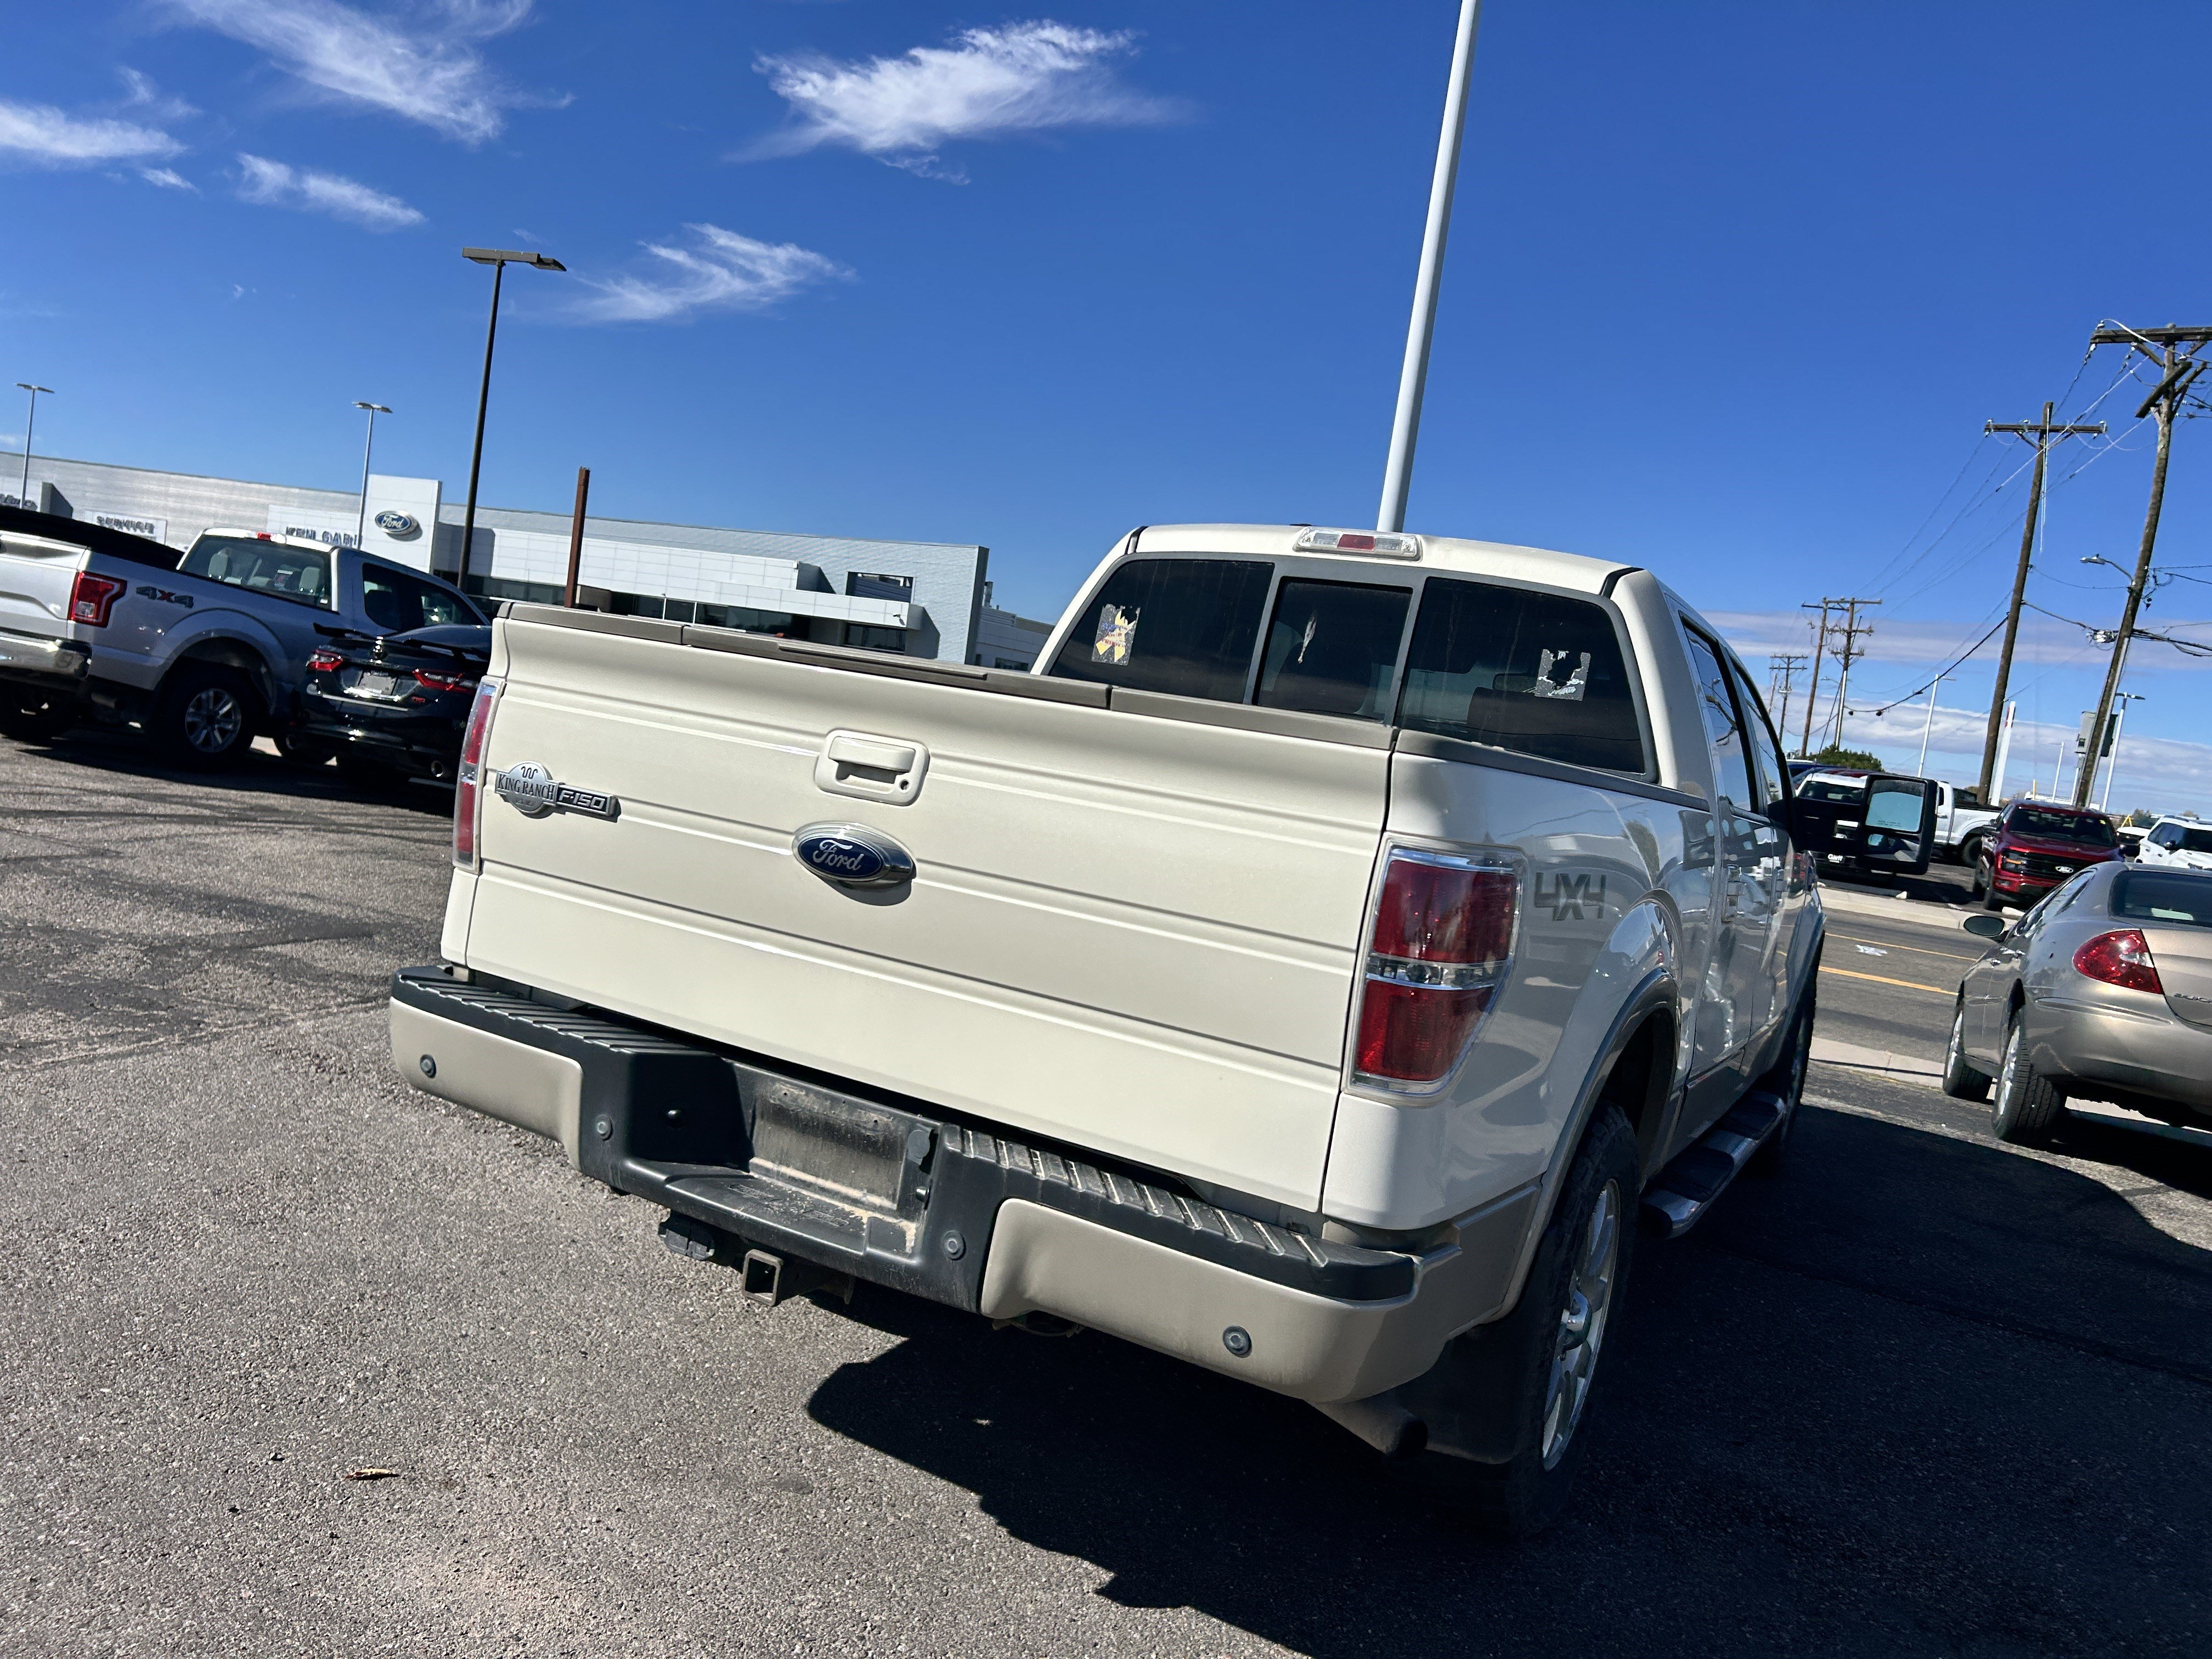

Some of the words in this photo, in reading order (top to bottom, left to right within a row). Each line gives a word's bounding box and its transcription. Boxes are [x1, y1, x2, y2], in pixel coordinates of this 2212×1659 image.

[97, 515, 155, 535] SERVICE
[381, 514, 403, 529] Ford
[286, 526, 317, 540] KEN
[498, 774, 521, 794] KING
[522, 781, 555, 800] RANCH
[558, 789, 606, 809] F-150
[812, 839, 865, 871] Ford
